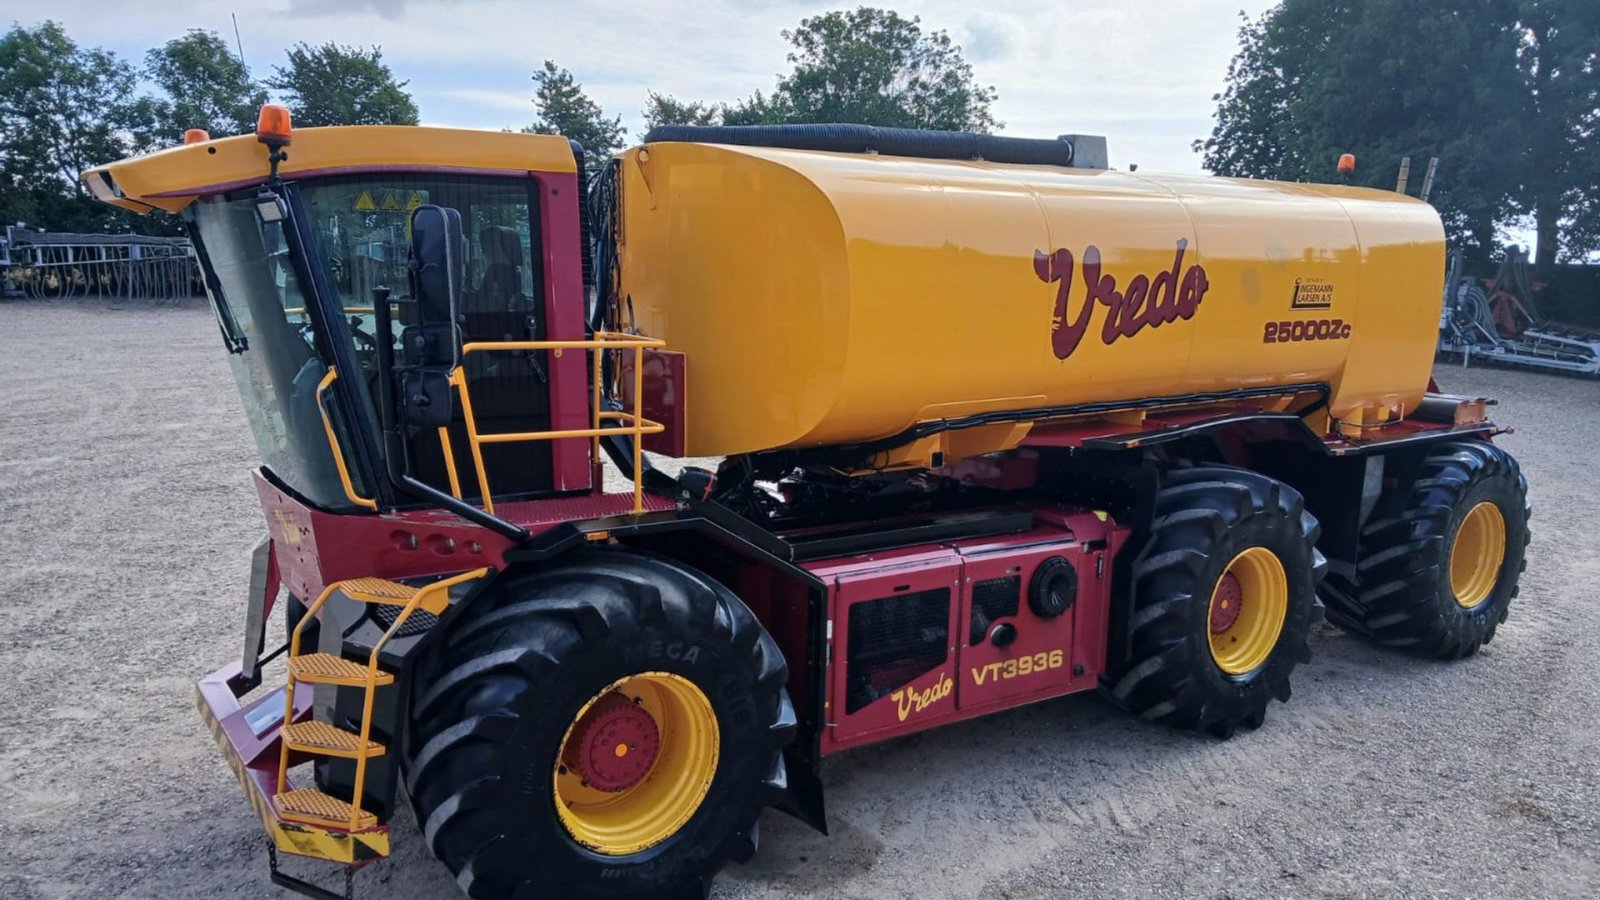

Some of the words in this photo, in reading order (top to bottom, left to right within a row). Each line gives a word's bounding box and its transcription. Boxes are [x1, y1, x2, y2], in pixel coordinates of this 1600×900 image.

[1033, 237, 1209, 361] Vredo
[971, 649, 1064, 686] VT3936
[891, 672, 953, 722] Vredo
